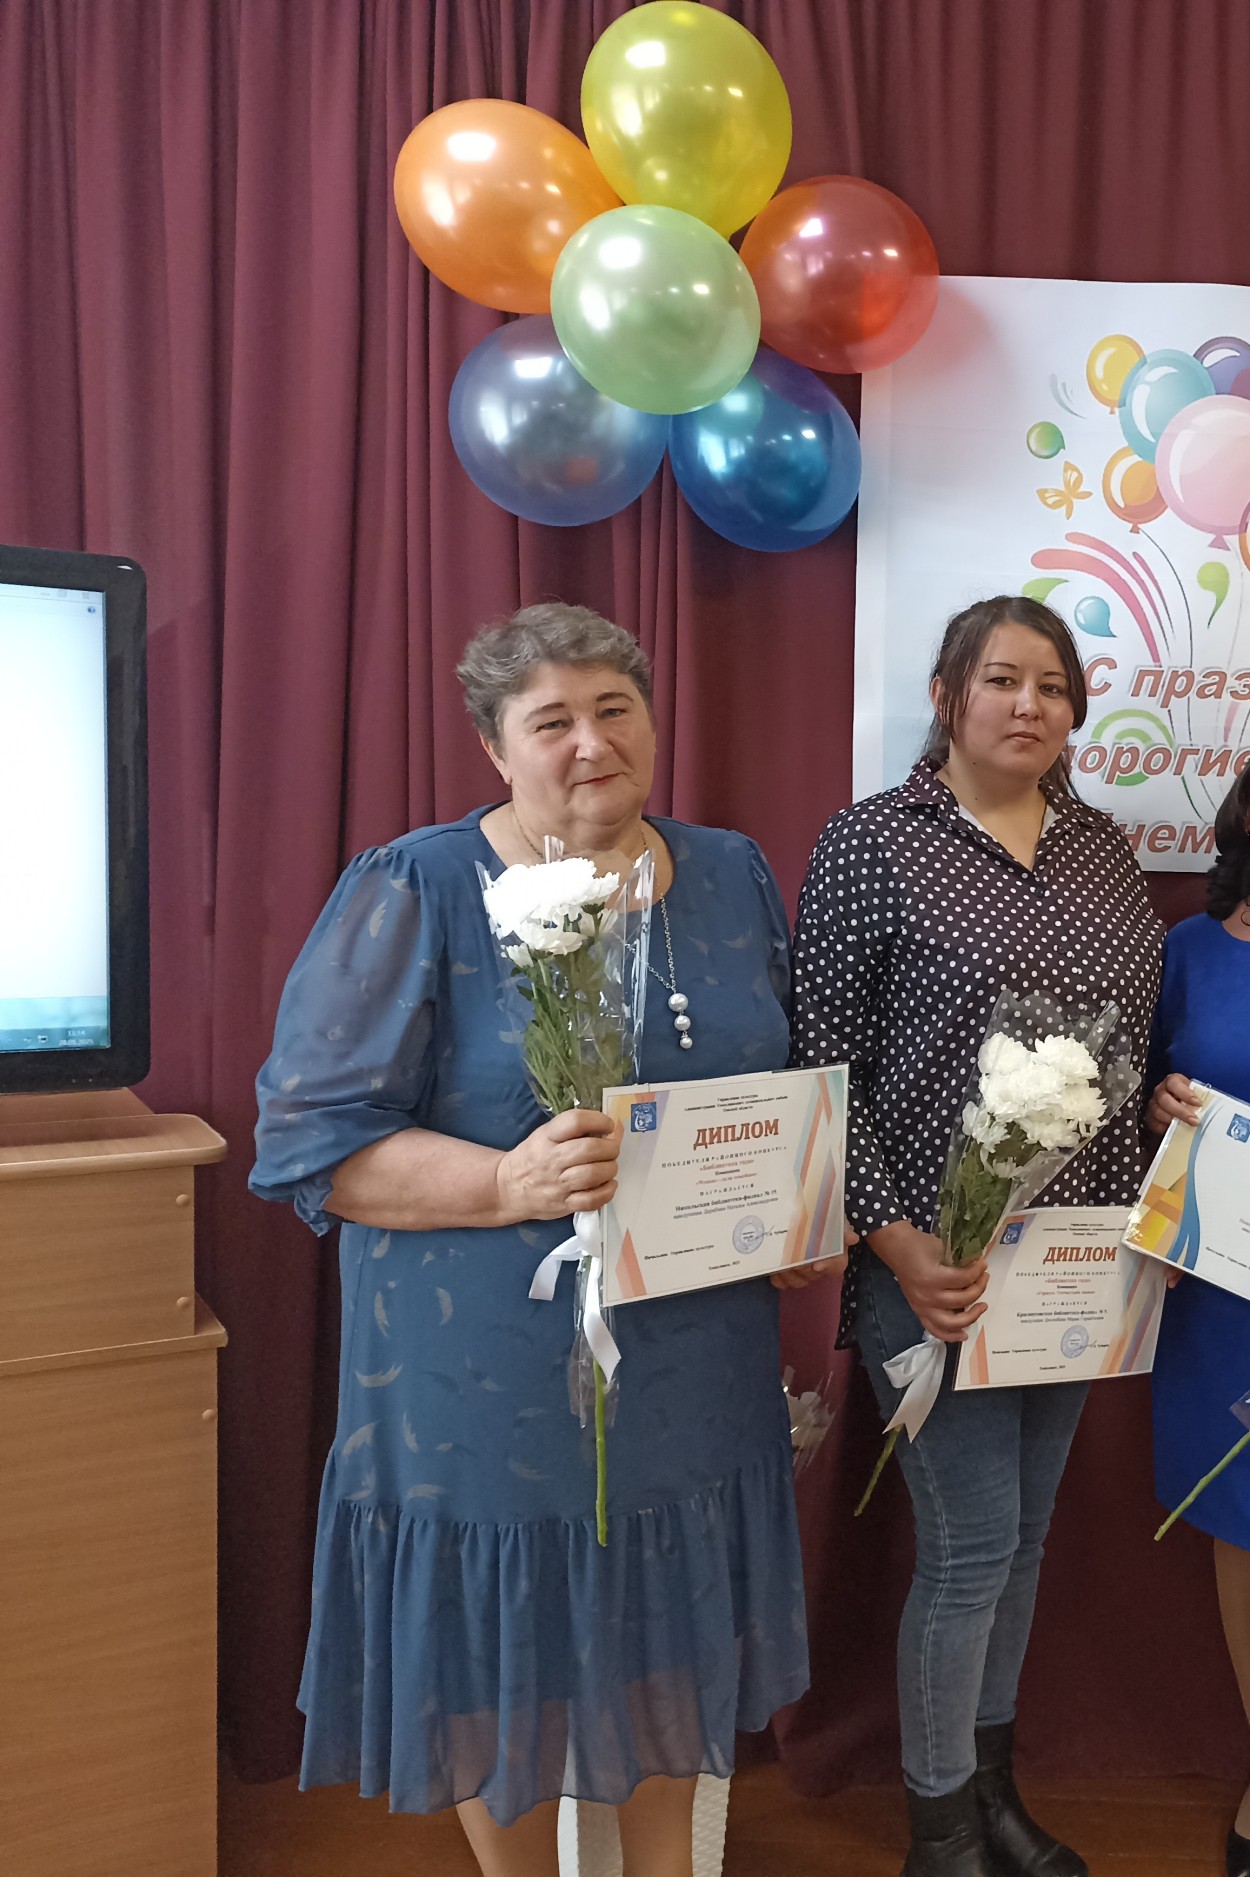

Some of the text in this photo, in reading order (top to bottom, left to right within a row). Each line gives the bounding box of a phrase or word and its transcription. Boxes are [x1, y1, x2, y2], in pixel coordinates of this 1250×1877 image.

[1084, 656, 1118, 697] С
[1104, 812, 1216, 854] нем
[693, 1118, 779, 1151] ДИПЛОМ
[1042, 1246, 1118, 1265] ДИПЛОМ
